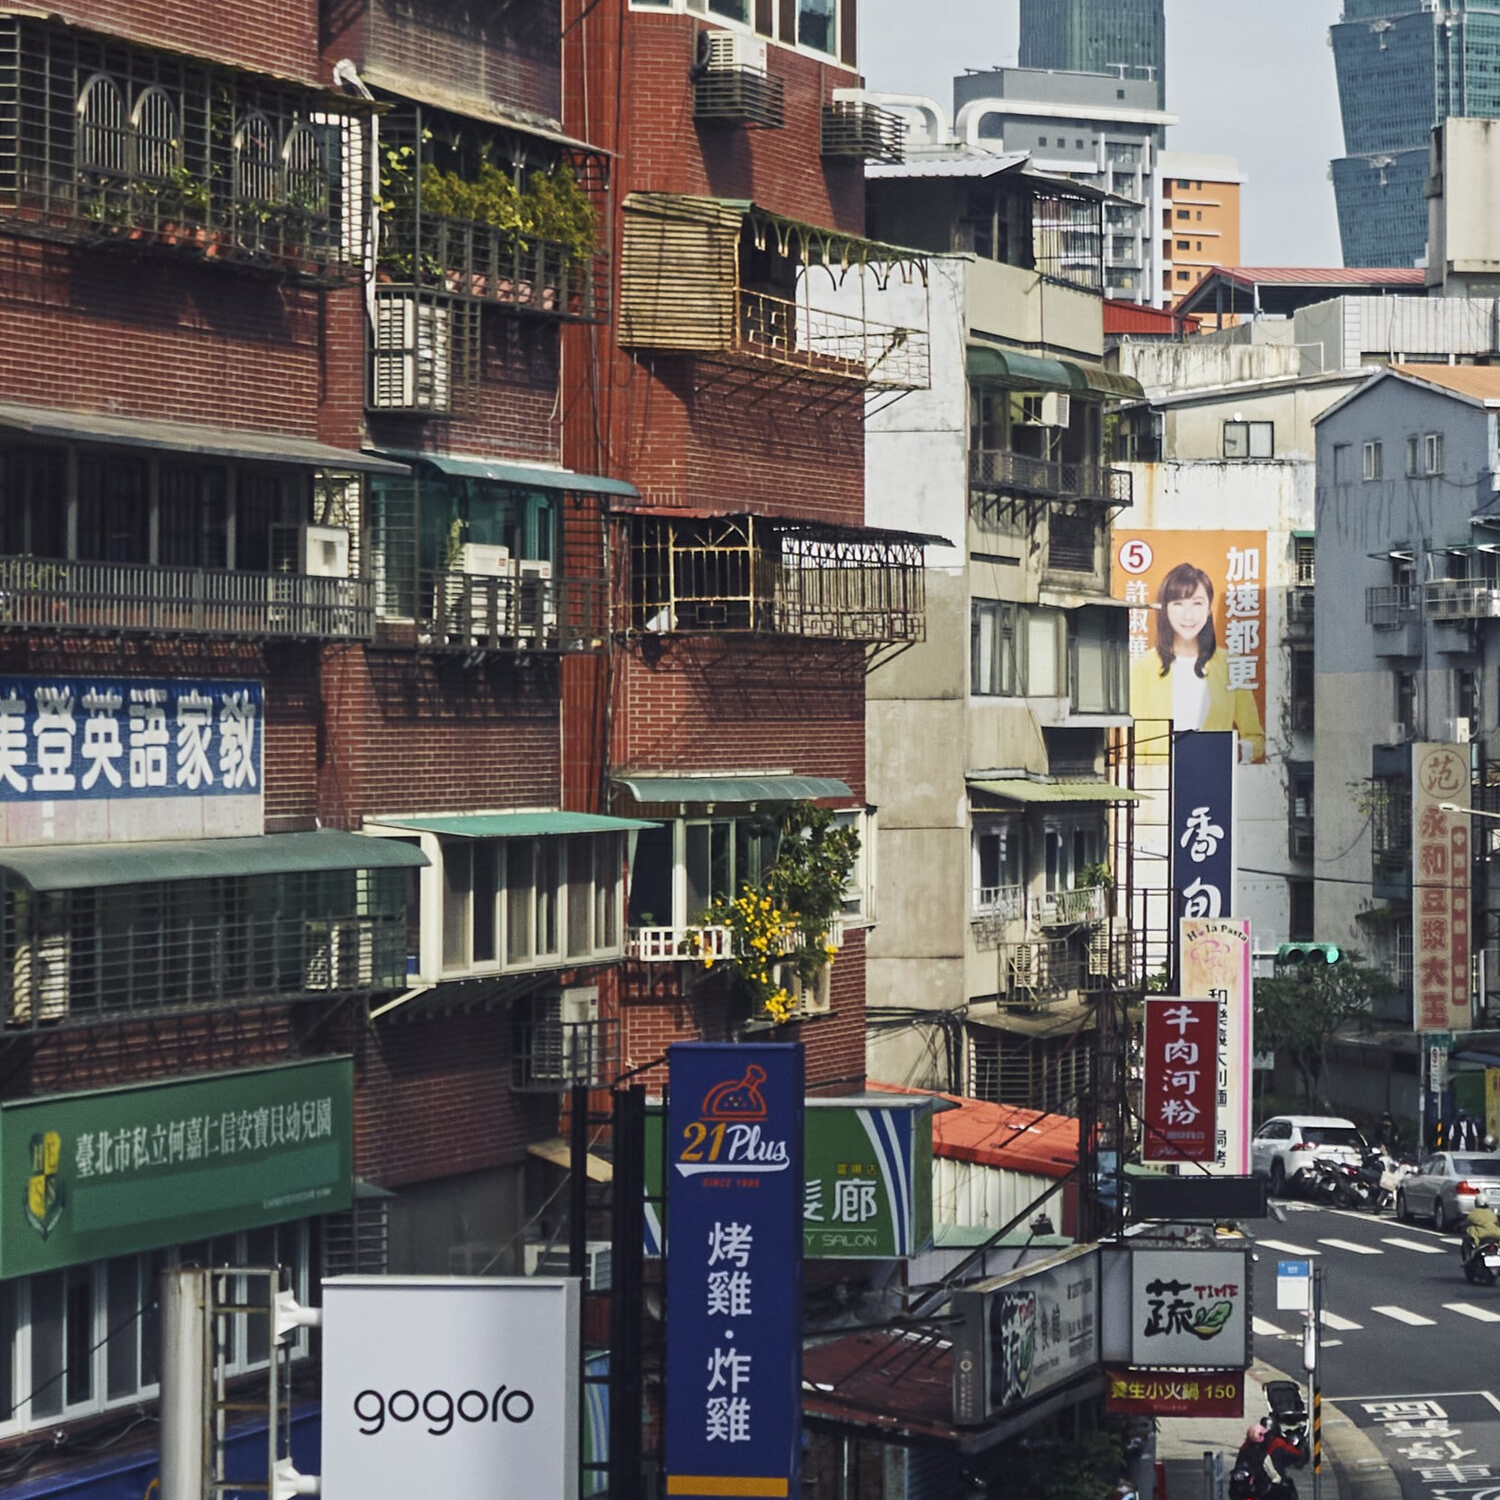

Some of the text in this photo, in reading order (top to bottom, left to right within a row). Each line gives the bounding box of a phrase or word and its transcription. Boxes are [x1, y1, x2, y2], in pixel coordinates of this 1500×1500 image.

[1128, 545, 1144, 569] 5
[1225, 546, 1260, 692] 加速都更
[1420, 804, 1449, 1028] 永和豆漿大王
[1160, 1005, 1200, 1125] 牛肉河粉
[824, 1235, 878, 1247] SALON
[1194, 1284, 1239, 1300] TIME
[1111, 1380, 1236, 1401] 養生小火鍋 150
[353, 1384, 535, 1437] gogoro
